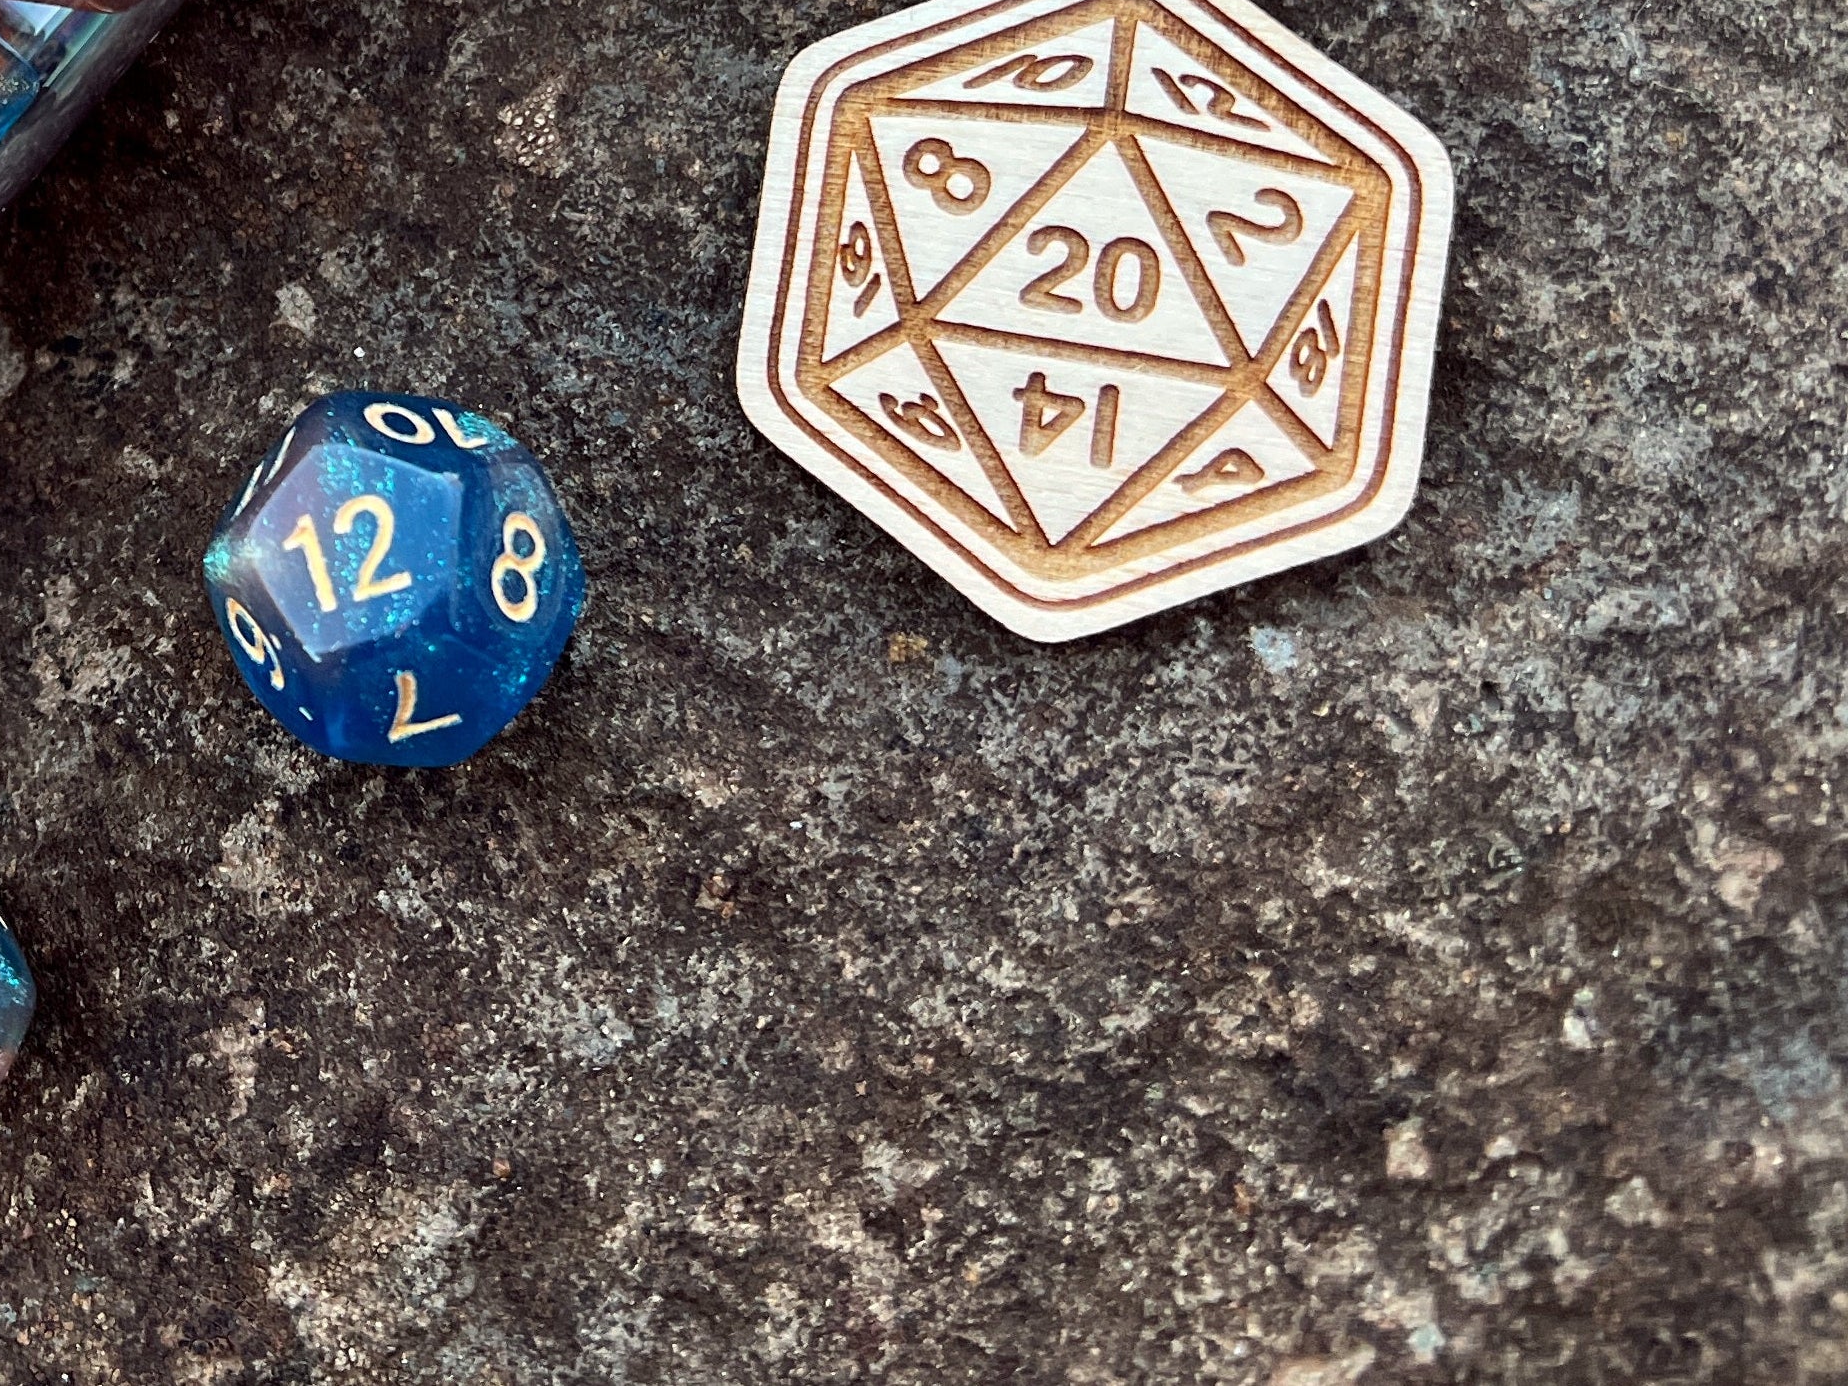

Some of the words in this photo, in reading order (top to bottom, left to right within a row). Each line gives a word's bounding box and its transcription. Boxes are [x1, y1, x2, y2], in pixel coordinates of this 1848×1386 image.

[962, 53, 1094, 91] 10
[1151, 66, 1271, 131] 12
[903, 138, 991, 216] 8
[1205, 187, 1304, 266] 2
[1018, 224, 1160, 324] 20
[1290, 298, 1341, 398] 18
[363, 402, 492, 450] 10
[1011, 370, 1121, 470] 14
[1173, 446, 1266, 494] 4
[281, 494, 413, 614] 12
[490, 511, 547, 624] 8
[388, 670, 464, 744] 7
